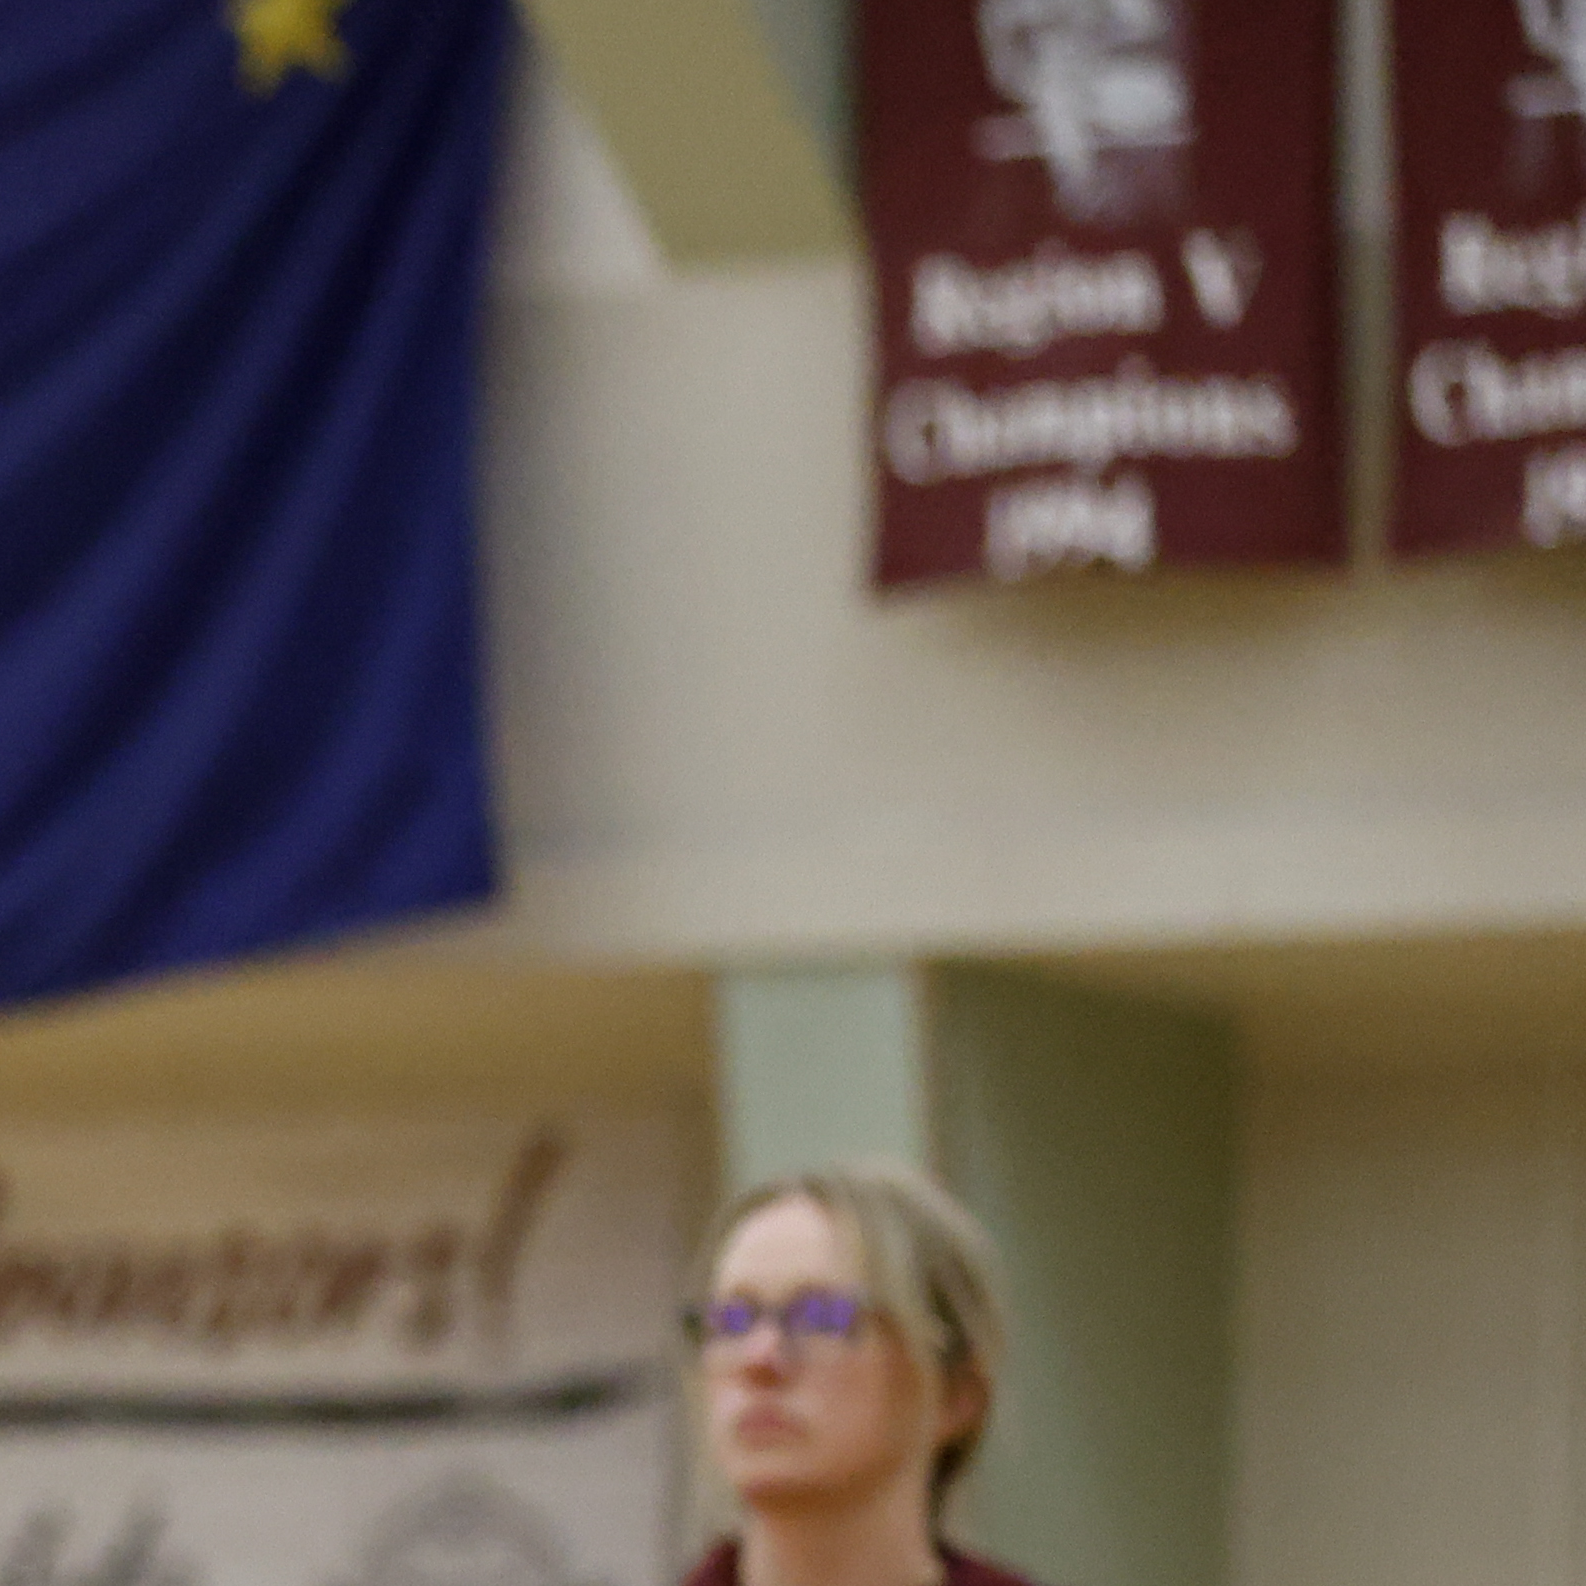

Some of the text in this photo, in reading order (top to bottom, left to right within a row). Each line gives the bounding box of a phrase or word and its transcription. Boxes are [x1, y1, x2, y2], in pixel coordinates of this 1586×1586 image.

[911, 228, 1266, 358] Region V
[884, 355, 1297, 485] Champions
